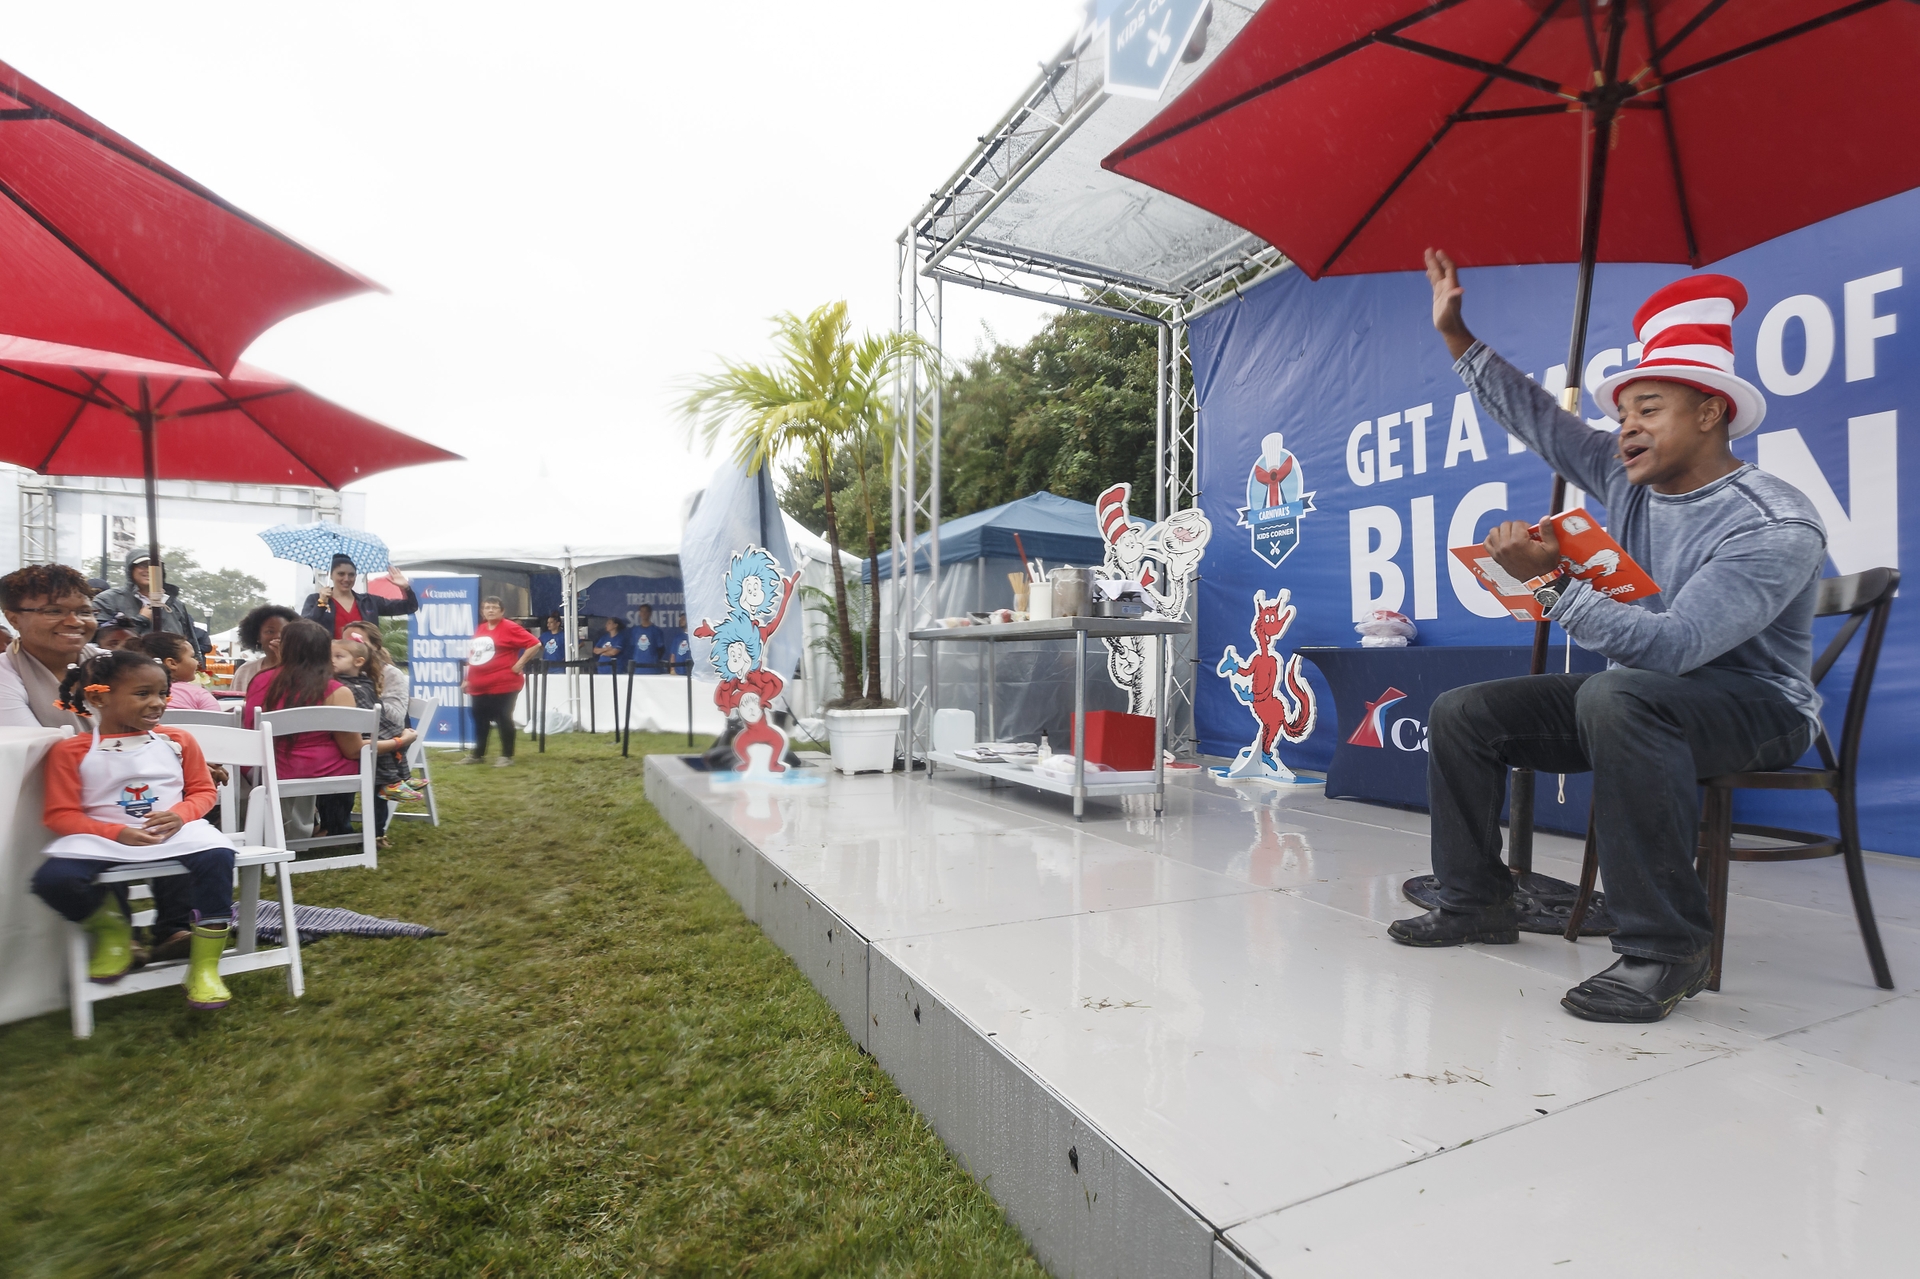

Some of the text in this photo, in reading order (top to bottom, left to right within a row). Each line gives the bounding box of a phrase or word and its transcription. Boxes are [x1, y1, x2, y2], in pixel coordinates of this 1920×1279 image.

[1117, 8, 1146, 52] KIDS
[1346, 402, 1433, 487] GET
[1444, 391, 1488, 468] A
[1756, 267, 1903, 396] OF
[1258, 506, 1290, 521] CARNIVAL'S
[1257, 528, 1294, 540] KIDS CORNER
[626, 593, 657, 605] TREAT
[415, 603, 474, 636] YUM
[413, 639, 445, 659] FOR
